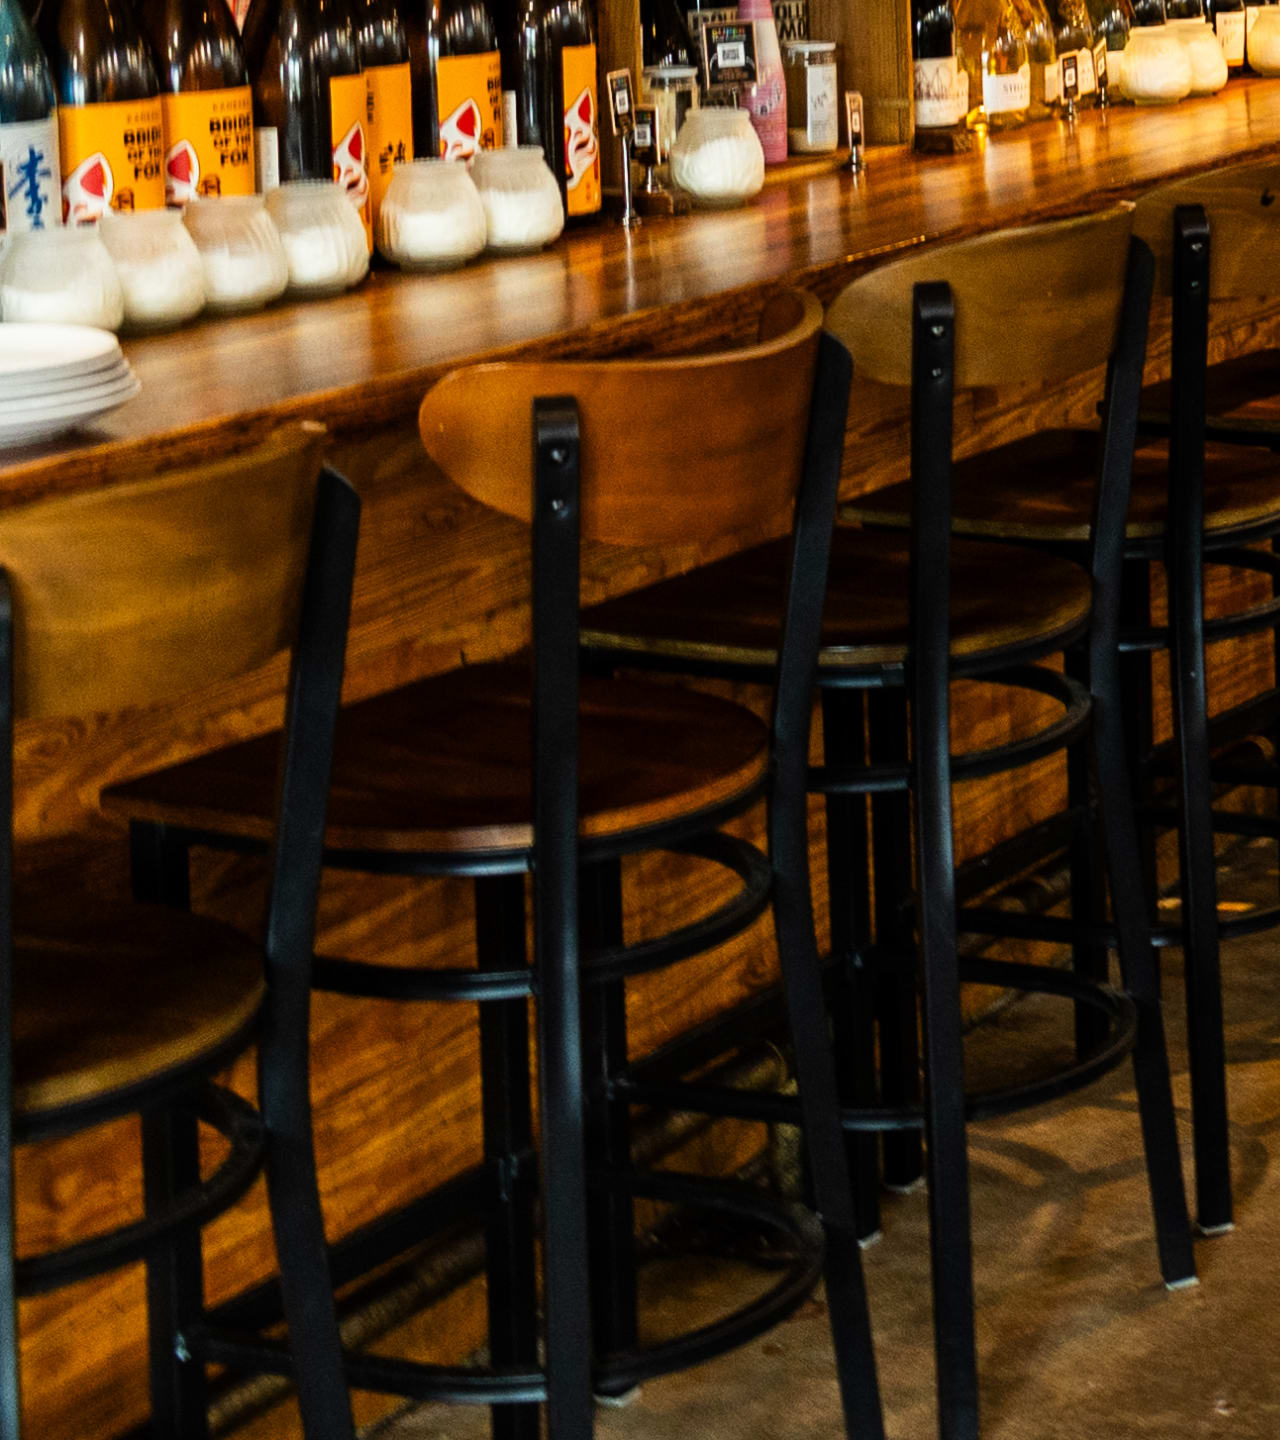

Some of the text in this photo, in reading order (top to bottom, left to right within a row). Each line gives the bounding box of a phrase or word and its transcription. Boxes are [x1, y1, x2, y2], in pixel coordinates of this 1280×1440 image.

[209, 112, 251, 135] BRIDE
[220, 150, 249, 168] FOX
[134, 160, 161, 181] FOX
